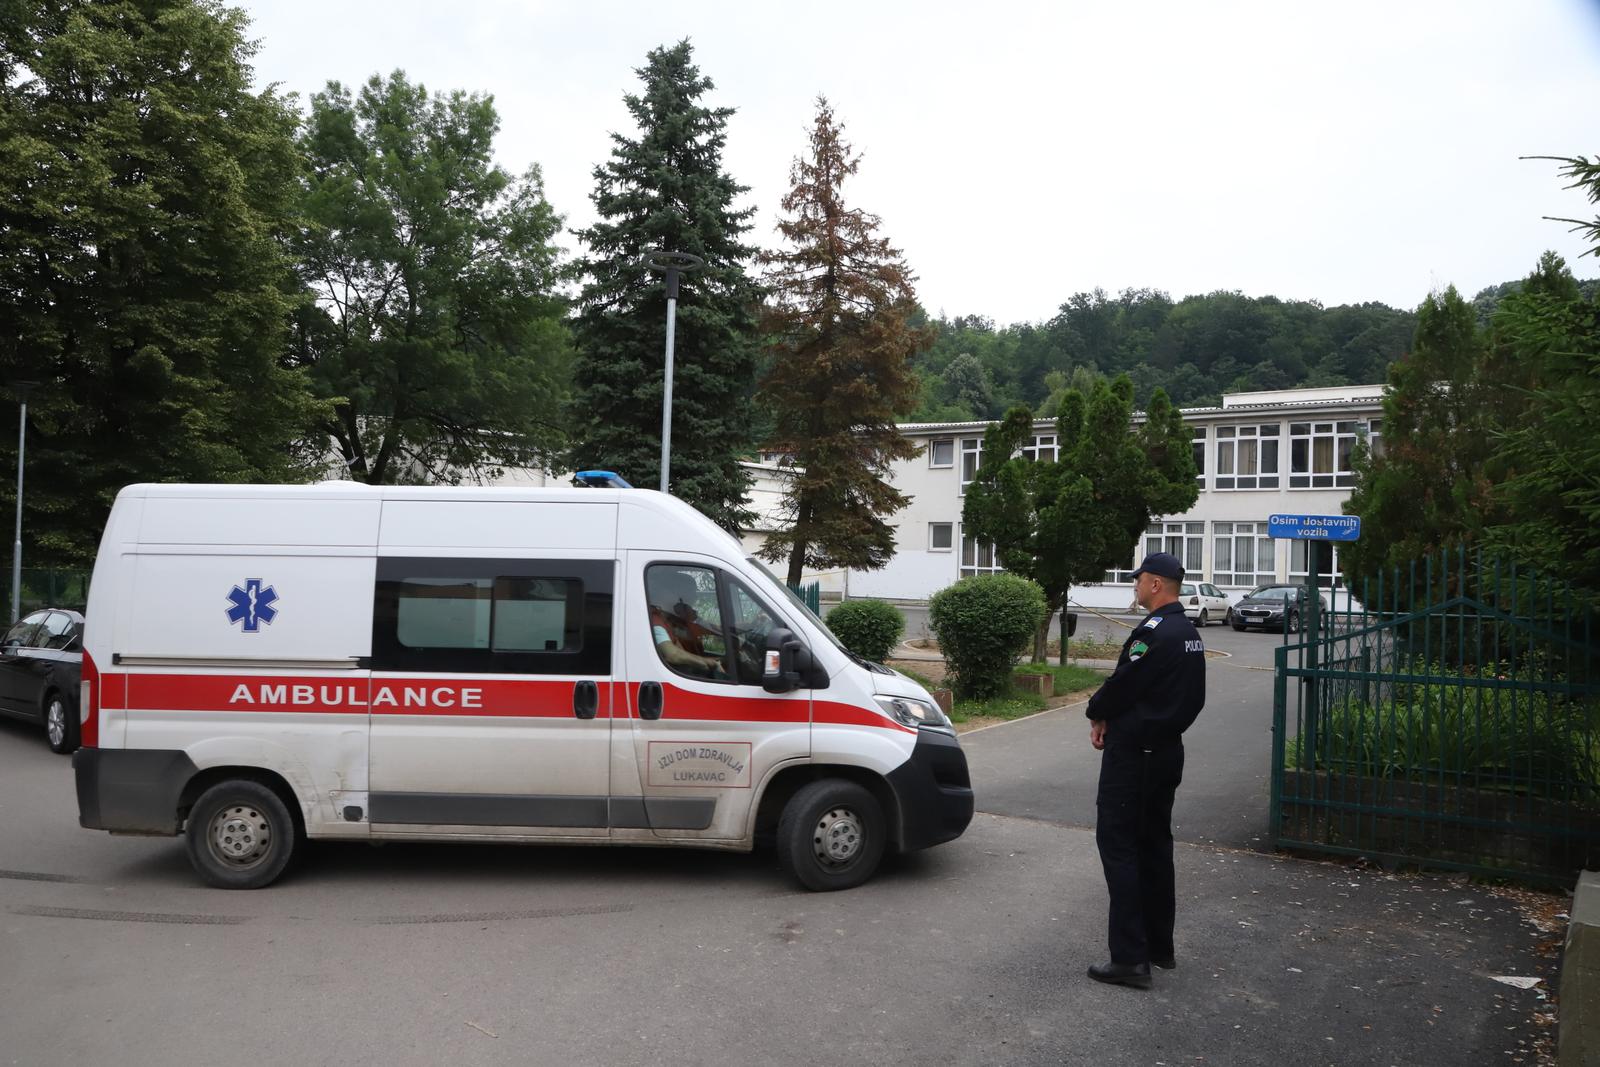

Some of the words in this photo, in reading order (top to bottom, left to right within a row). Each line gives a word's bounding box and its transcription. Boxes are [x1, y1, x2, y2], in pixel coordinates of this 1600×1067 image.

[1270, 516, 1298, 525] Osim
[1303, 517, 1357, 527] dostavnih
[1297, 528, 1329, 537] vozila
[229, 684, 483, 708] AMBULANCE
[657, 754, 674, 769] JZU
[676, 748, 697, 761] DOM
[699, 748, 744, 774] ZDRAVLJA
[673, 772, 726, 781] LUKAVAC
